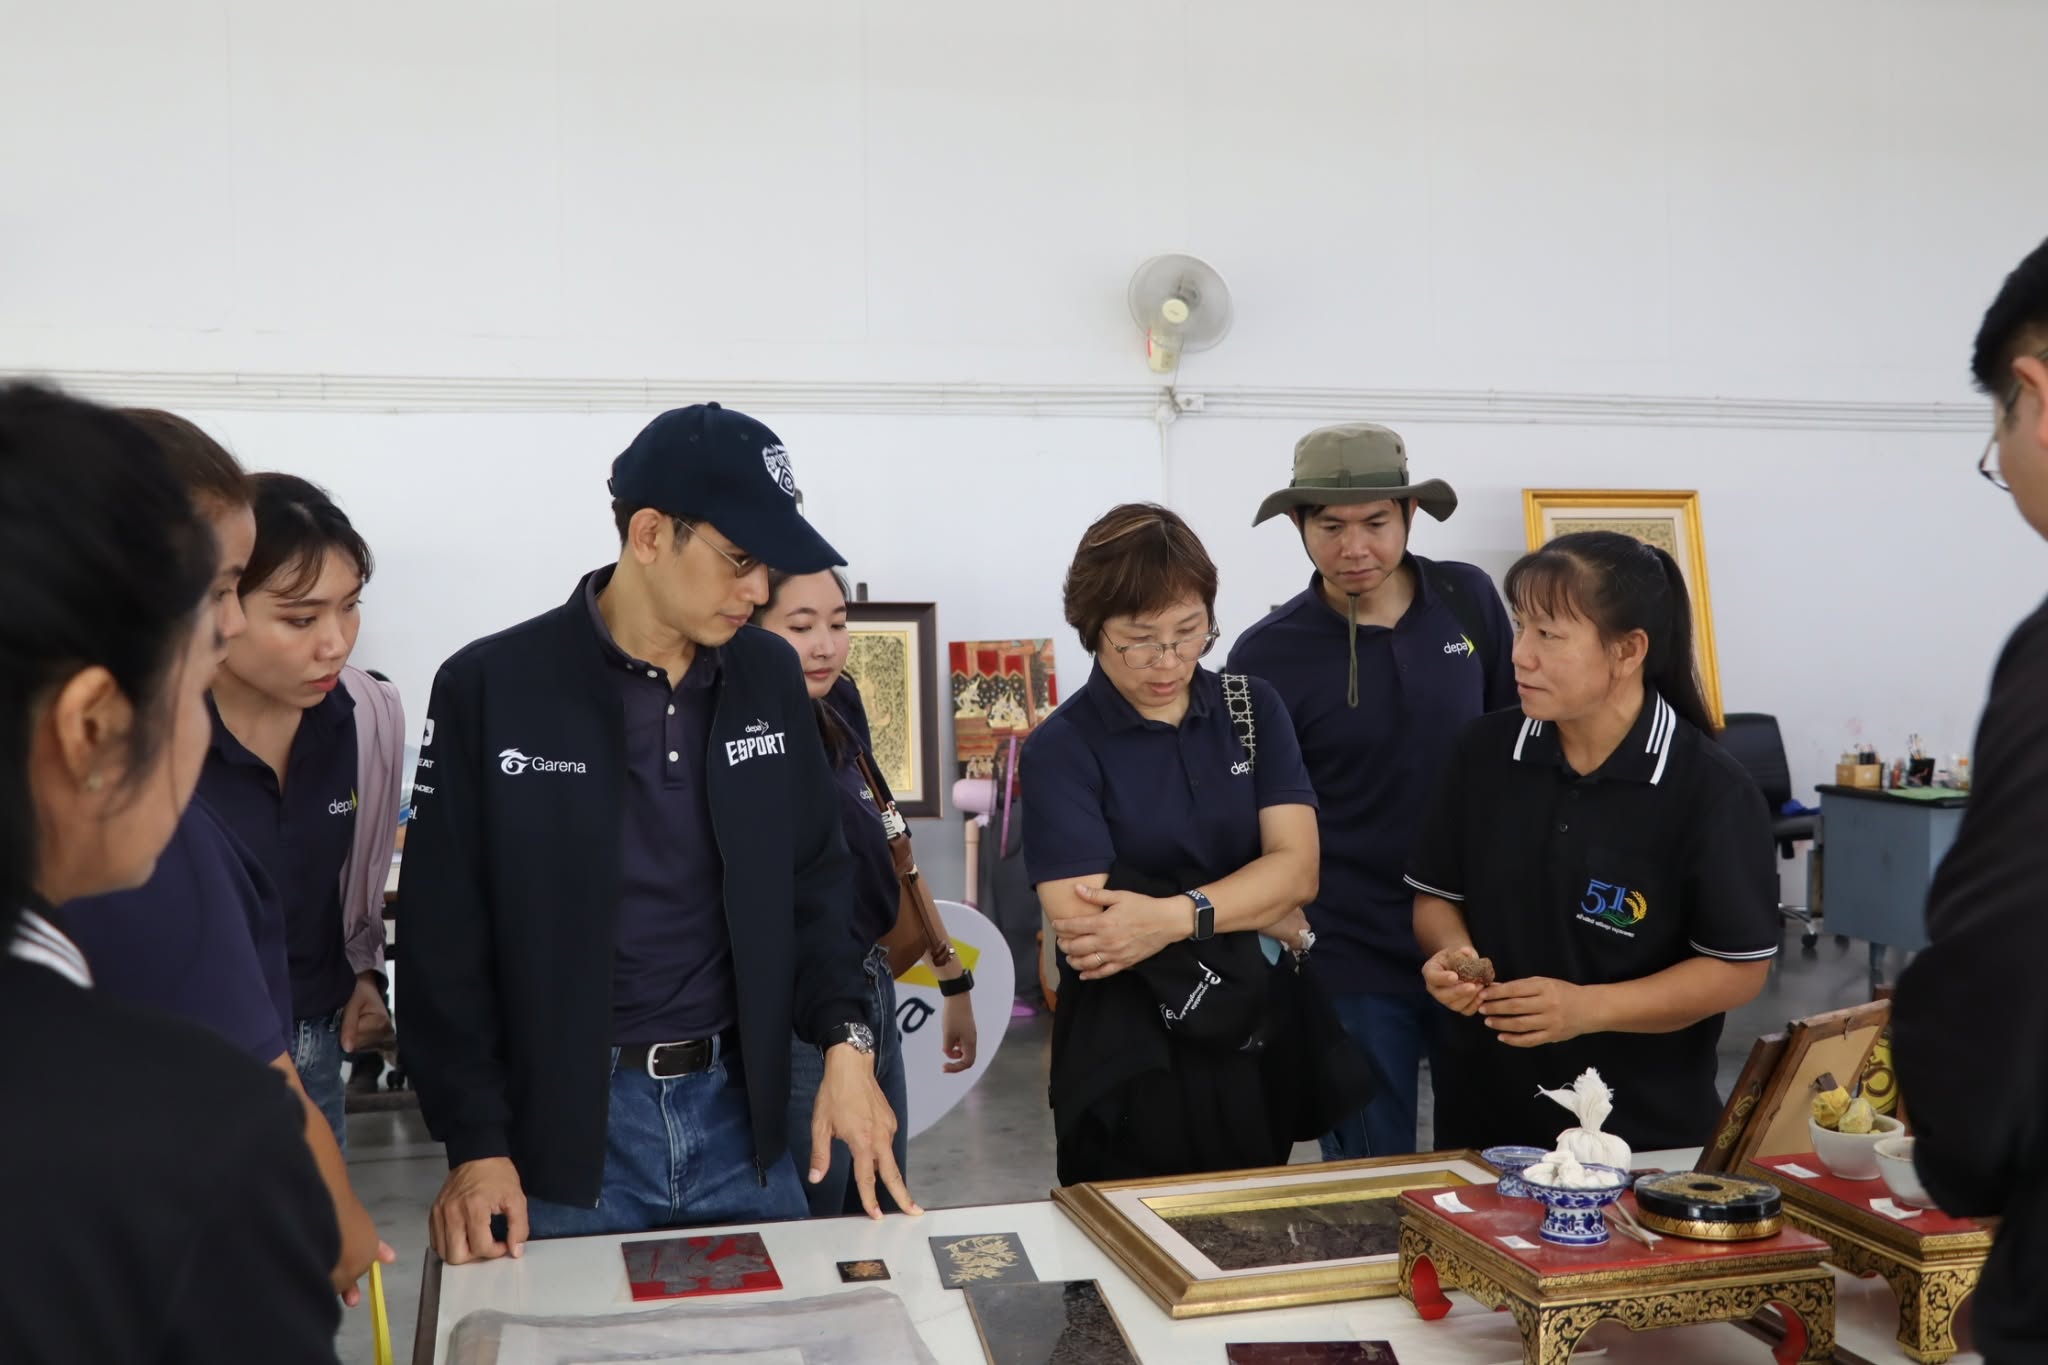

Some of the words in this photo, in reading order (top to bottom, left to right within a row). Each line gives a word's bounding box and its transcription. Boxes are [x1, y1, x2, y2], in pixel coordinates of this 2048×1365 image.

[1443, 641, 1468, 655] depa
[725, 732, 786, 766] ESPORT
[531, 756, 586, 774] Garena
[1230, 761, 1250, 775] dep
[1580, 878, 1627, 914] 51
